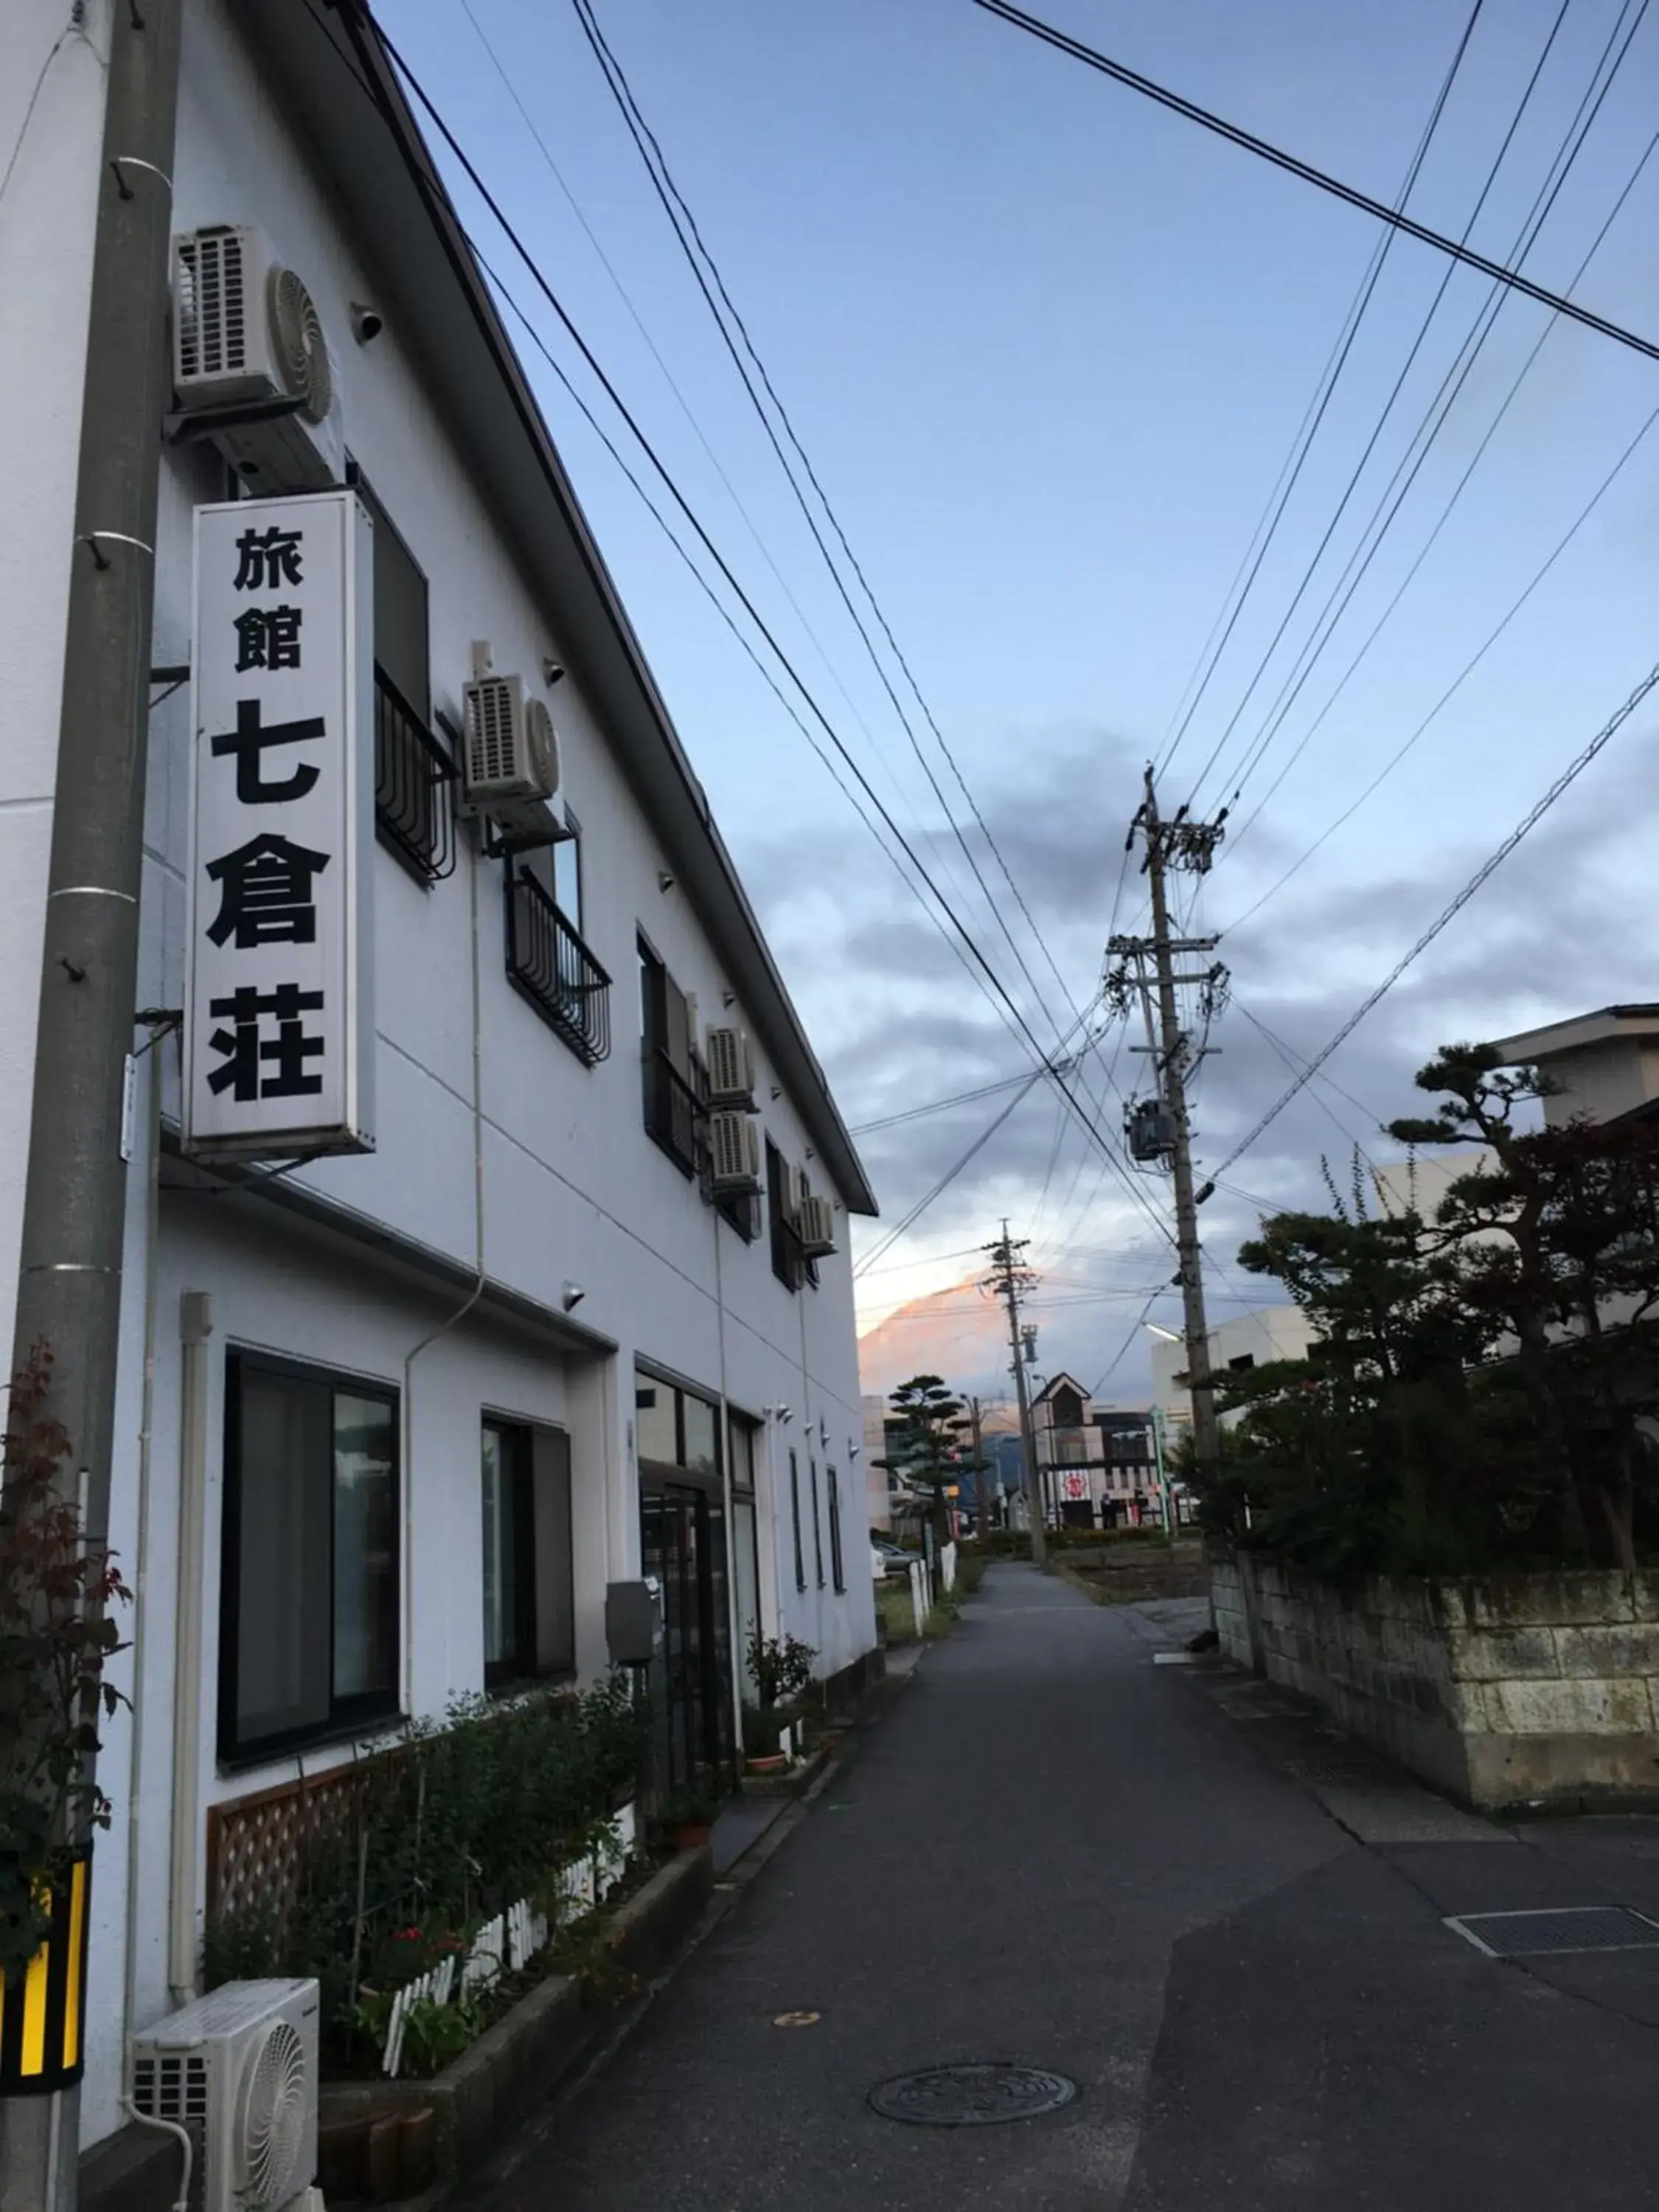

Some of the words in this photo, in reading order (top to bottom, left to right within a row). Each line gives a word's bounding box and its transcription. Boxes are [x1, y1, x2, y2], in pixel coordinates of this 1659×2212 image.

[206, 526, 330, 1102] 旅館七倉荘
